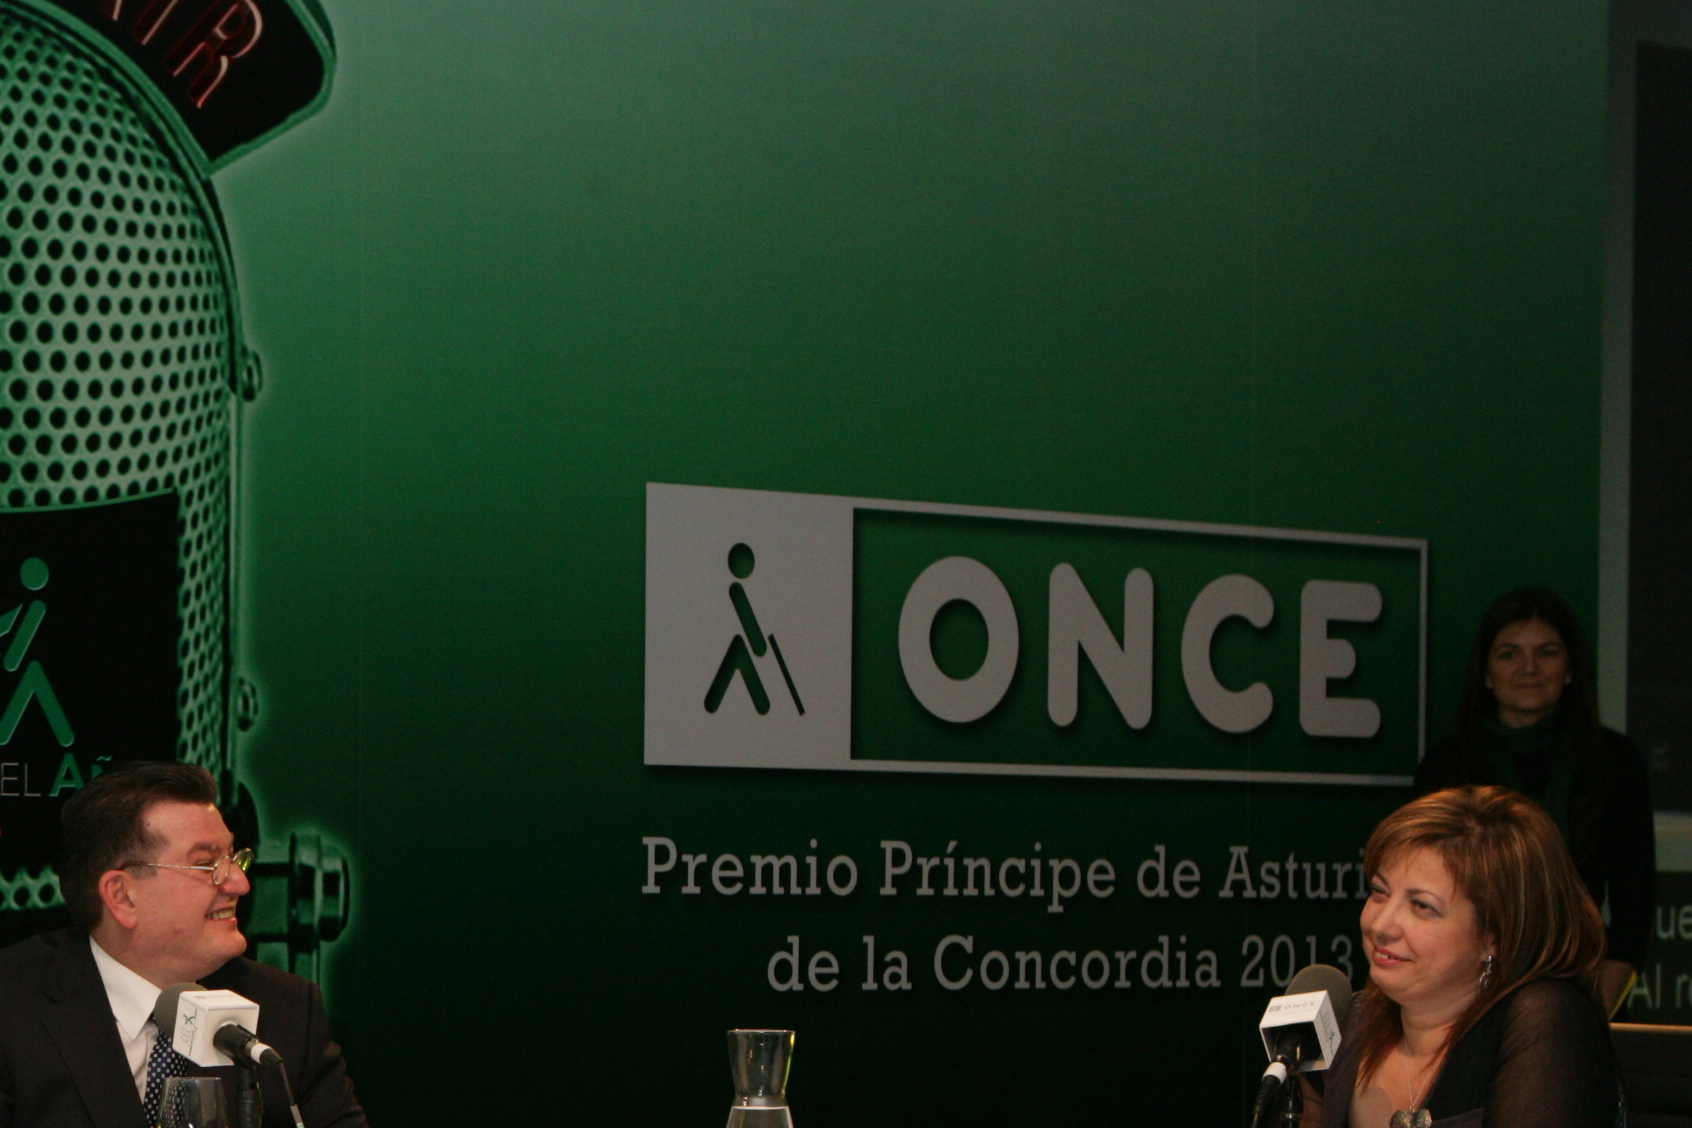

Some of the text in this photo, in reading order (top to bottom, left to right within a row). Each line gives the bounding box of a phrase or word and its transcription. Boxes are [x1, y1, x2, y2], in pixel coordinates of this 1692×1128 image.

[898, 556, 1382, 736] ONCE
[641, 836, 1368, 914] Premio Príncipe de Asturi
[767, 935, 840, 992] de
[861, 935, 912, 992] la
[934, 934, 1222, 992] Concordia
